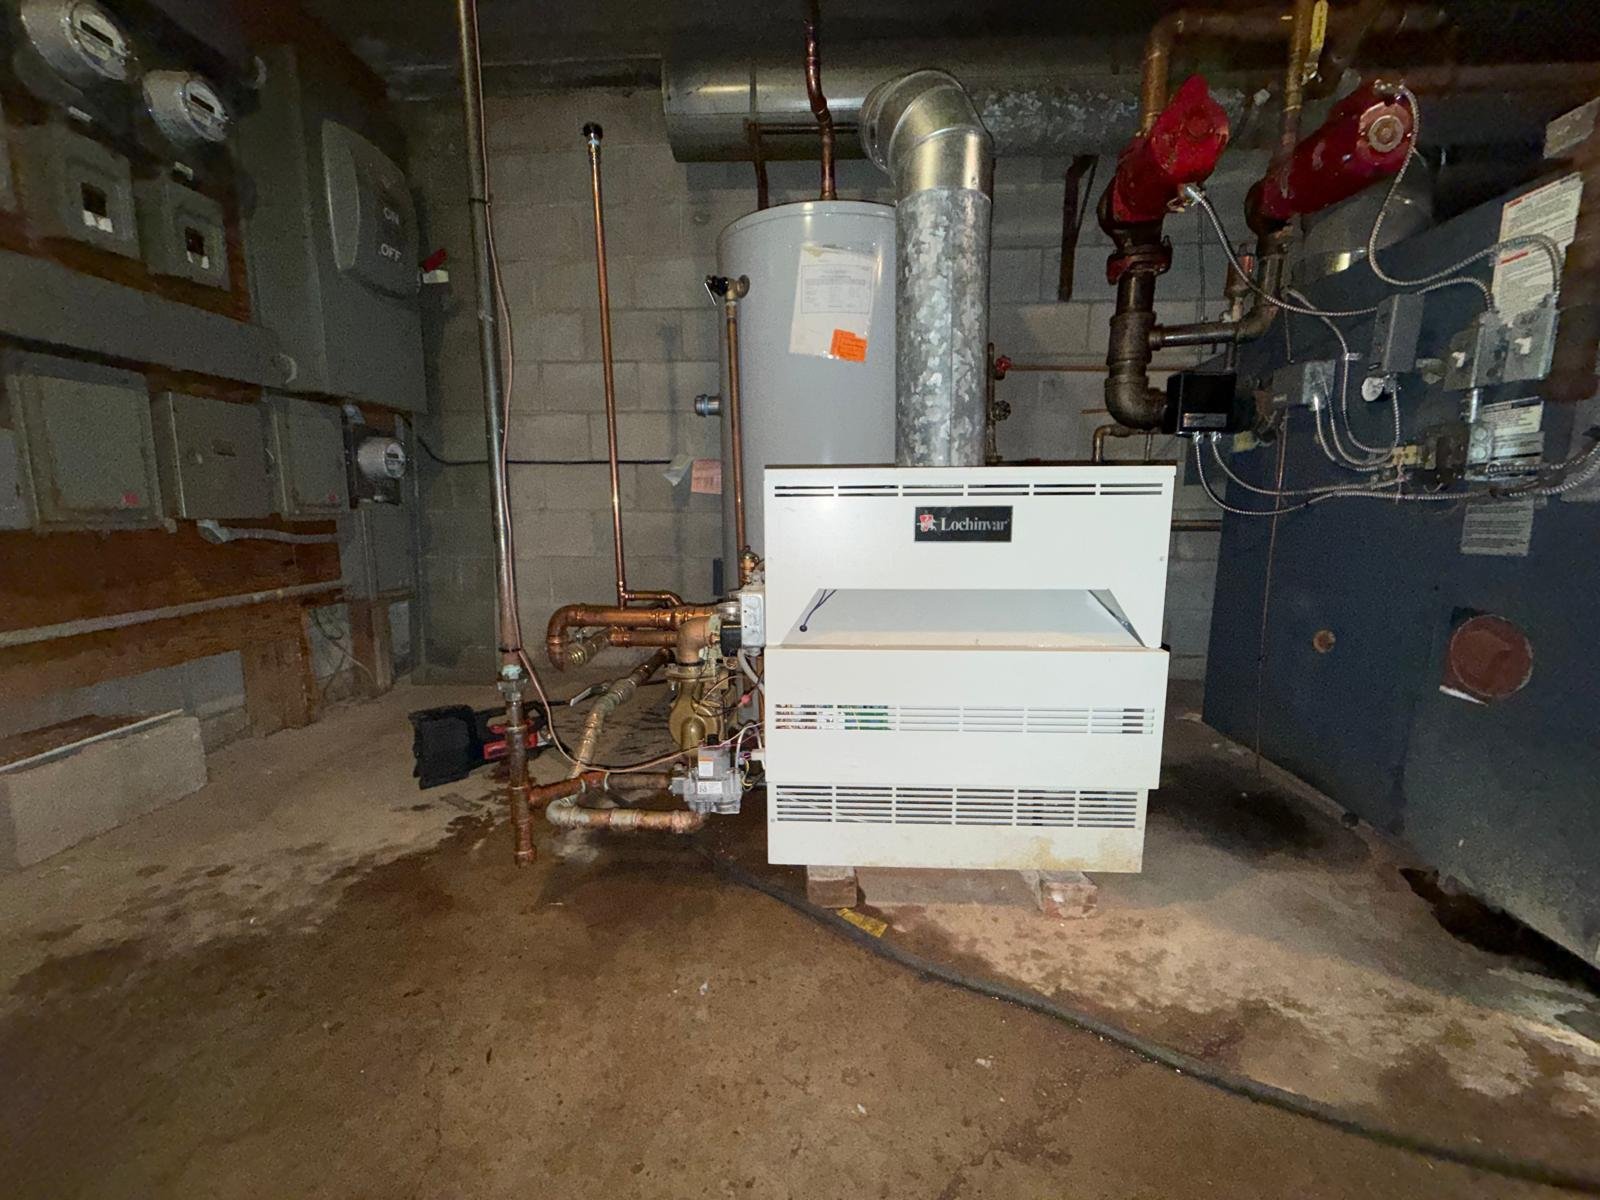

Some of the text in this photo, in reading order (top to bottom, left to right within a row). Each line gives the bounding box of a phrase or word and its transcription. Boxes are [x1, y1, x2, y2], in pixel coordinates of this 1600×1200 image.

[383, 207, 400, 225] ON
[380, 243, 402, 262] OFF
[941, 517, 1008, 531] Lochinvar
